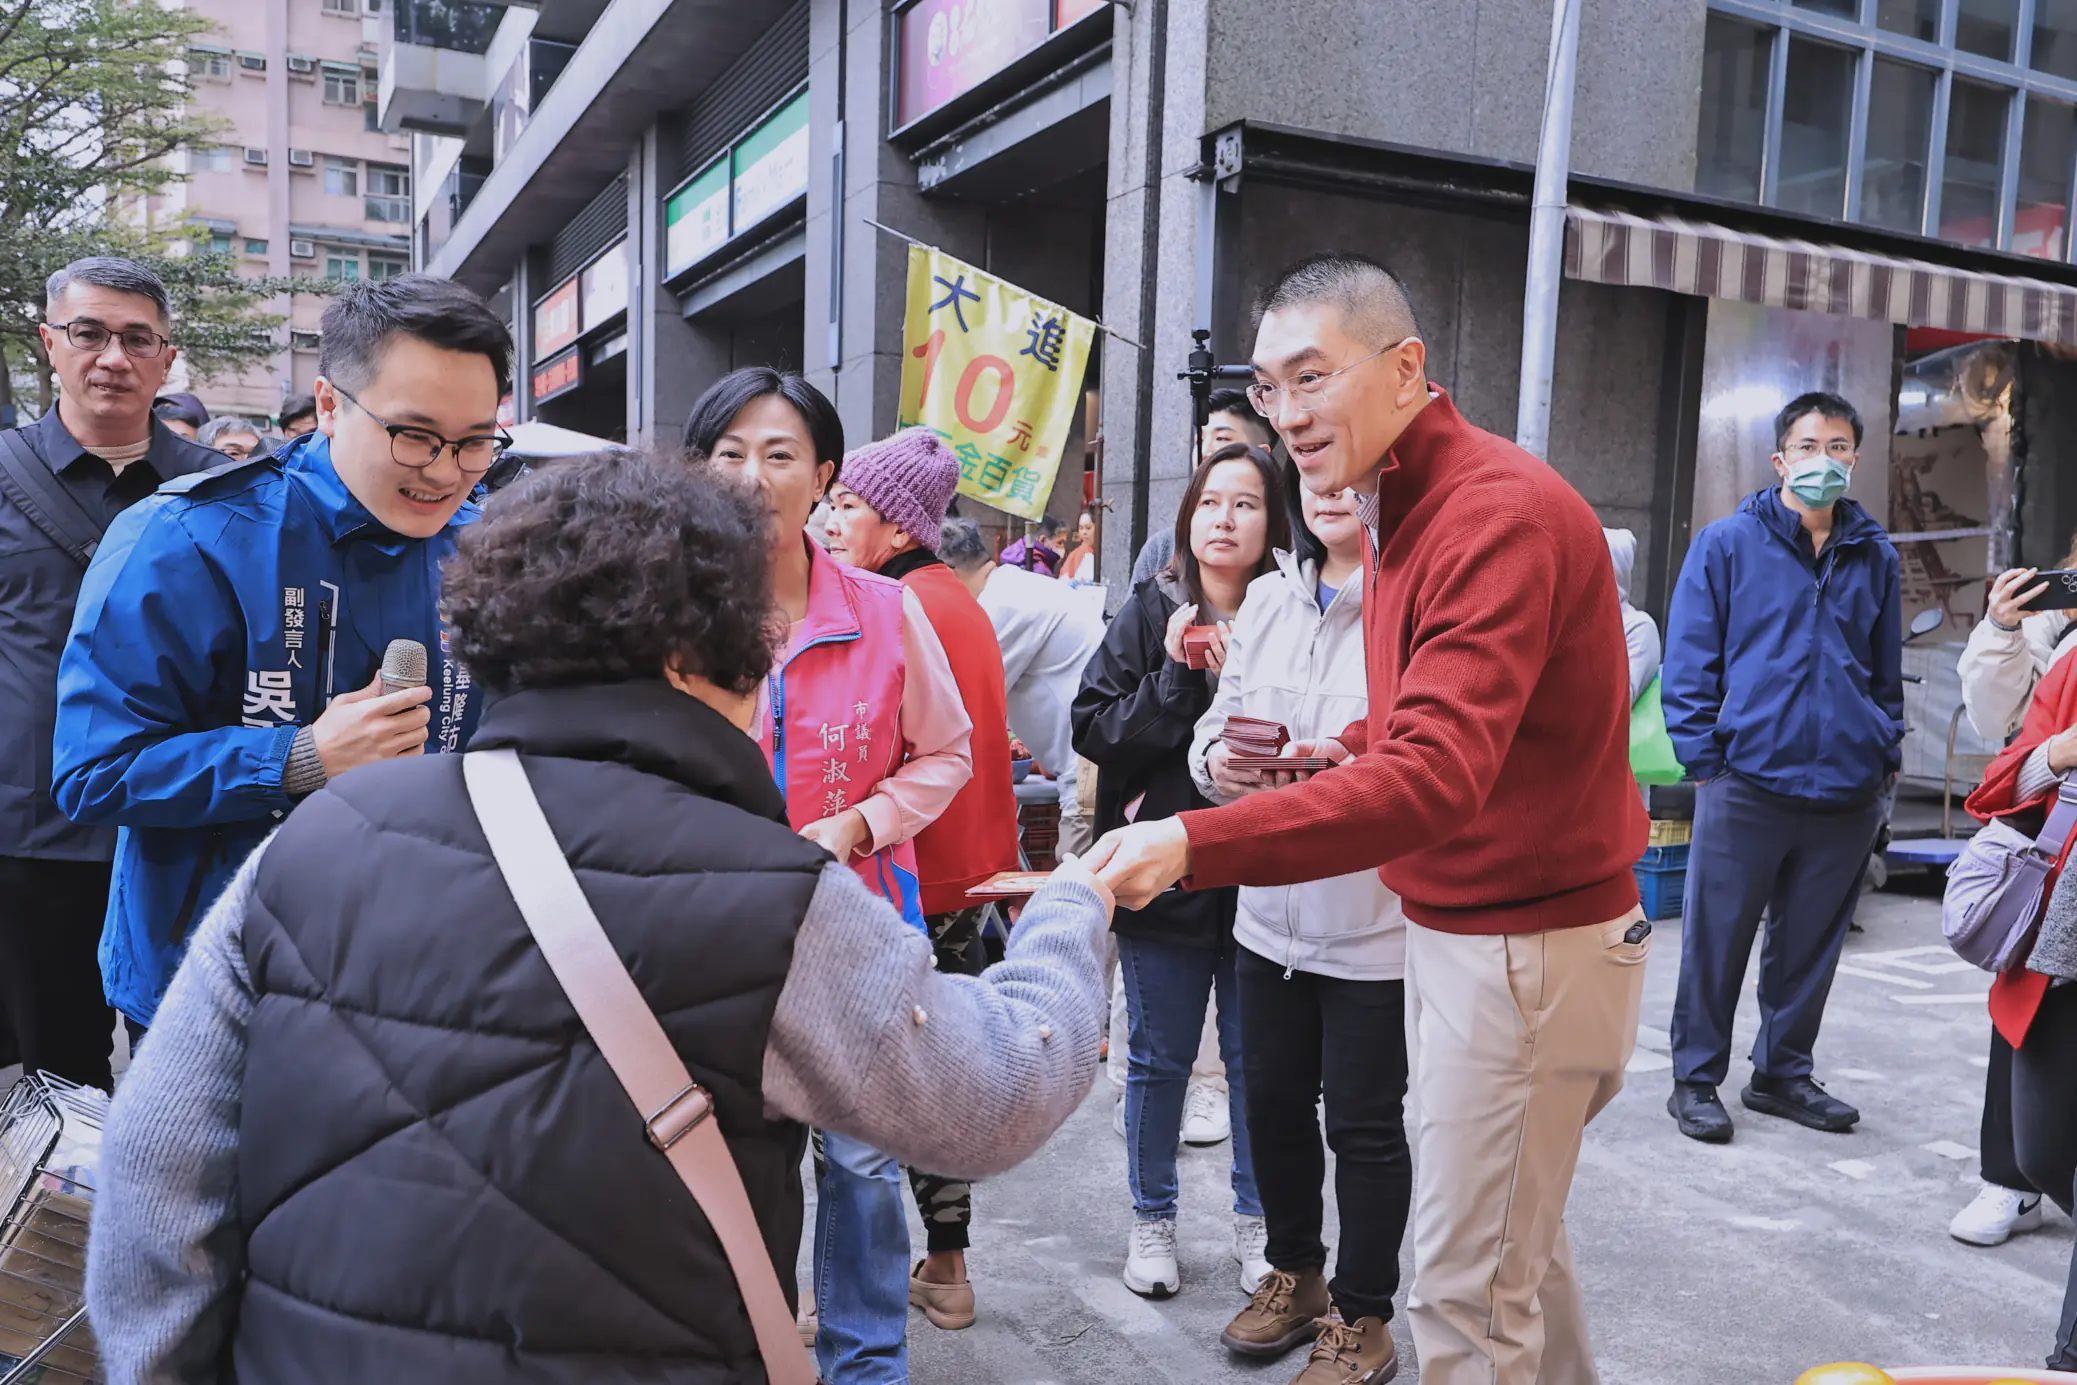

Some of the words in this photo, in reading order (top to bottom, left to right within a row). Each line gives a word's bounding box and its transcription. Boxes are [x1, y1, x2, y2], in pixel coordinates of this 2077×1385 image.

[928, 275, 1066, 372] 大進
[284, 587, 305, 669] 副發言人
[241, 670, 296, 729] 吳
[439, 659, 454, 712] Keelung
[438, 716, 451, 741] City
[852, 700, 872, 762] 市議員
[818, 722, 851, 817] 何淑萍
